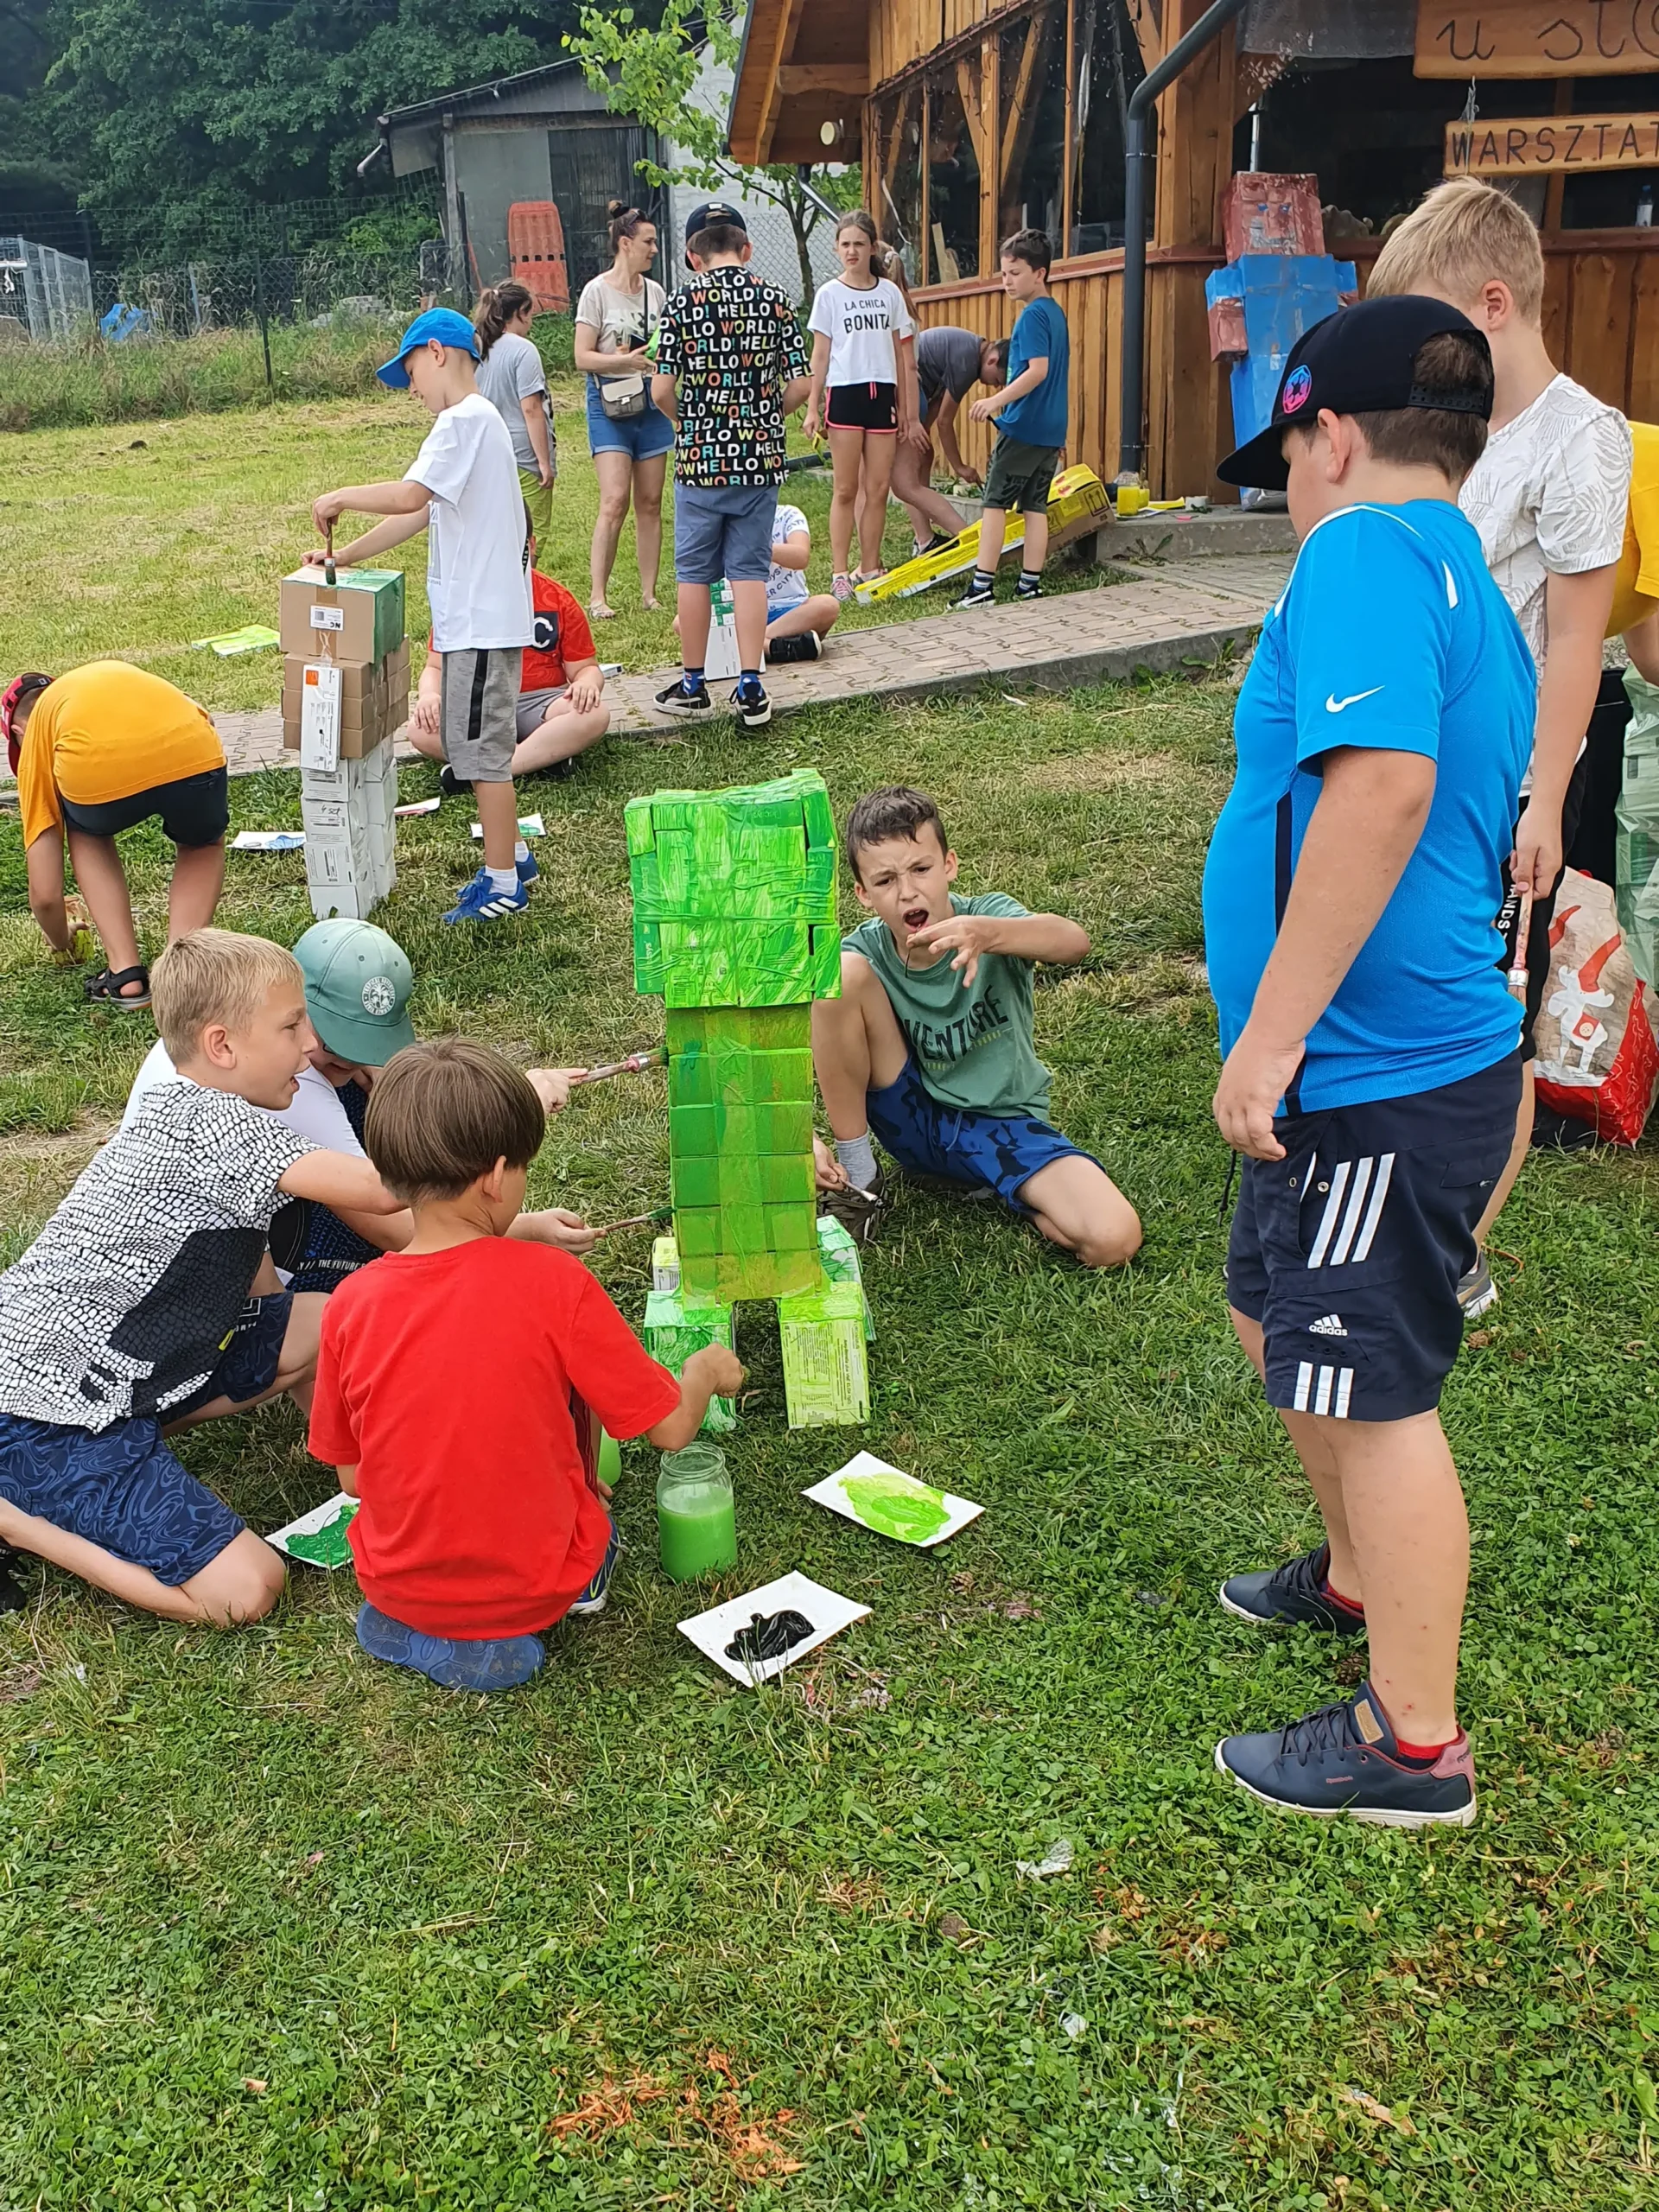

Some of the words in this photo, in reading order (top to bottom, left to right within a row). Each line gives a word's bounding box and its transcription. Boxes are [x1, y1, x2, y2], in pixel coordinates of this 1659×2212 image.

[1435, 18, 1496, 61] u
[692, 287, 760, 305] WORLD!
[717, 302, 771, 319] HELLO
[844, 301, 857, 311] LA
[859, 299, 886, 308] CHICA
[720, 319, 783, 335] WORLD!
[843, 313, 890, 334] BONITA
[691, 372, 753, 387] WORLD!
[705, 387, 754, 404] HELLO
[710, 397, 777, 419] WORLD!
[318, 1259, 331, 1268] THE
[1308, 1324, 1348, 1337] adidas
